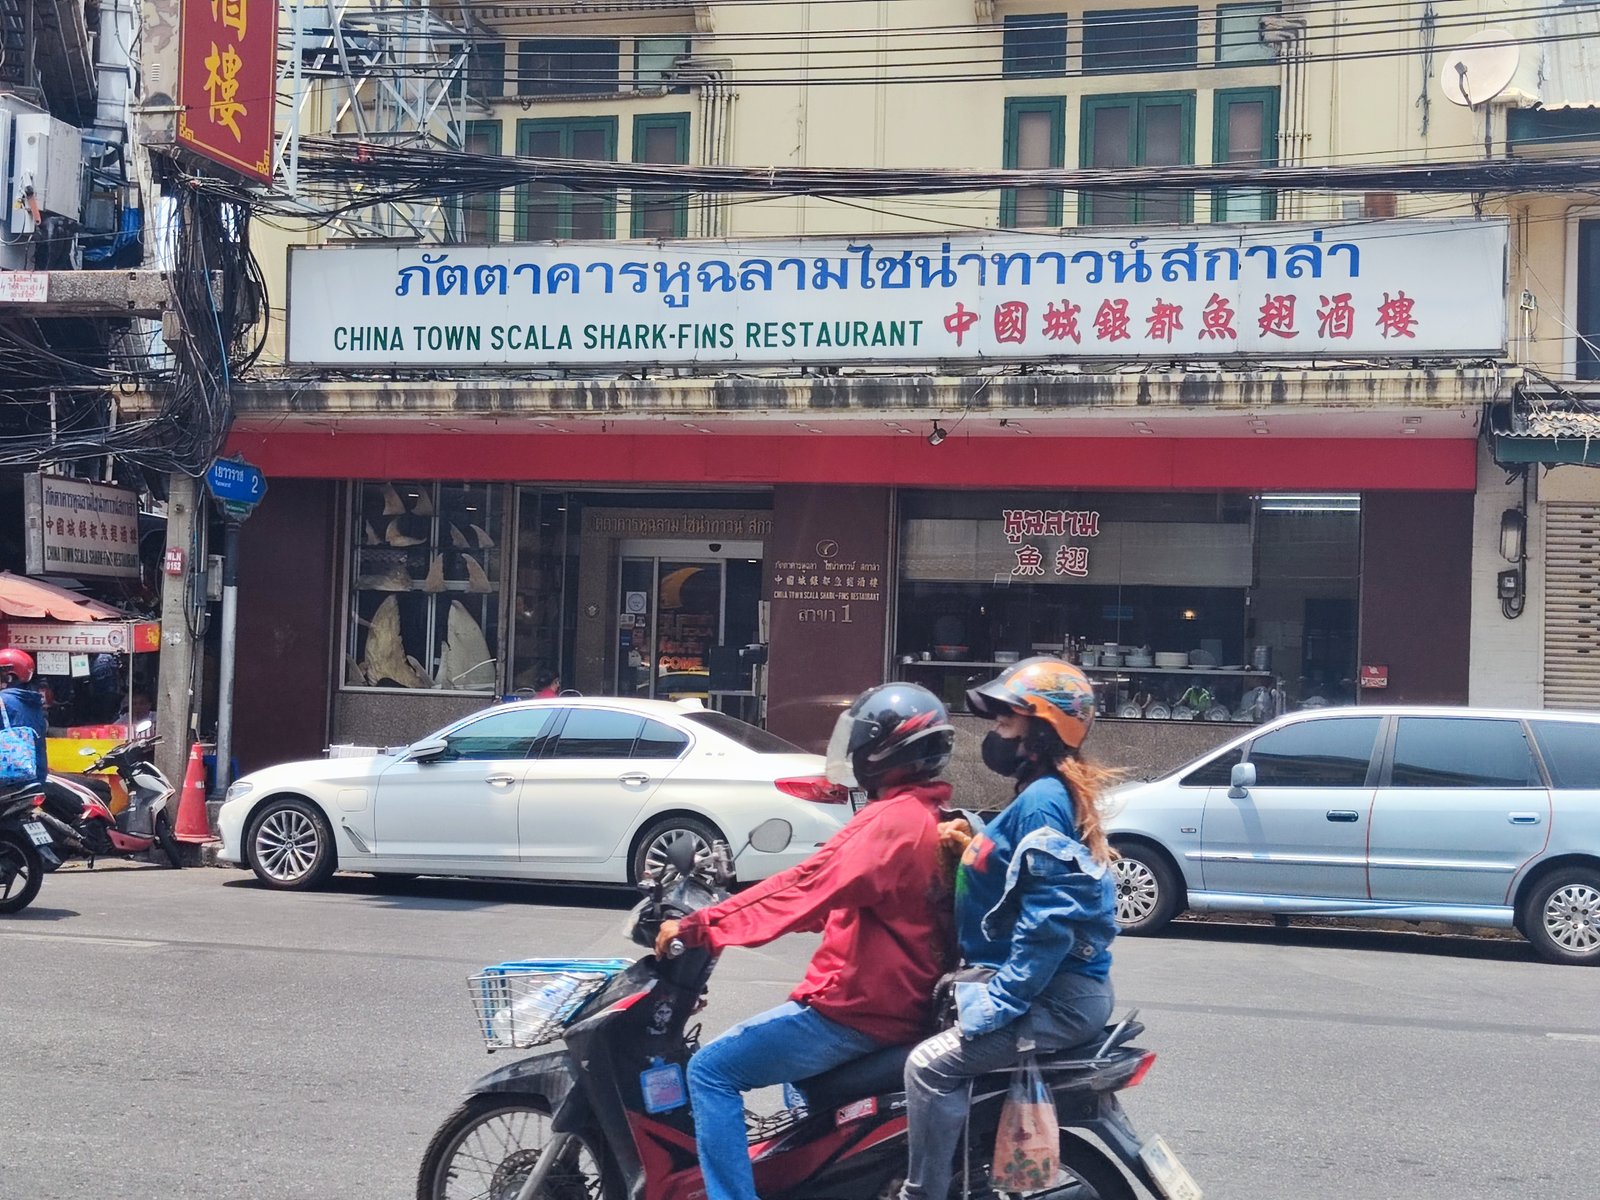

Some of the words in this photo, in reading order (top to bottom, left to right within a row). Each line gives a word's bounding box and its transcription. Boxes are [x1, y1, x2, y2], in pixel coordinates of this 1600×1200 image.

[395, 231, 1361, 308] ภัตตาคารหูฉลามไชน่าทาวน์สกาล่า
[334, 325, 404, 350] CHINA
[413, 325, 481, 350] TOWN
[491, 324, 573, 350] SCALA
[584, 322, 734, 349] SHARK-FINS
[746, 320, 923, 348] RESTAURANT
[943, 290, 1419, 347] 中國城銀都魚翅酒樓
[251, 475, 259, 494] 2
[1003, 510, 1100, 544] หูฉลาม
[1011, 544, 1089, 577] 魚翅
[798, 608, 836, 623] สาขา
[841, 603, 853, 623] 1
